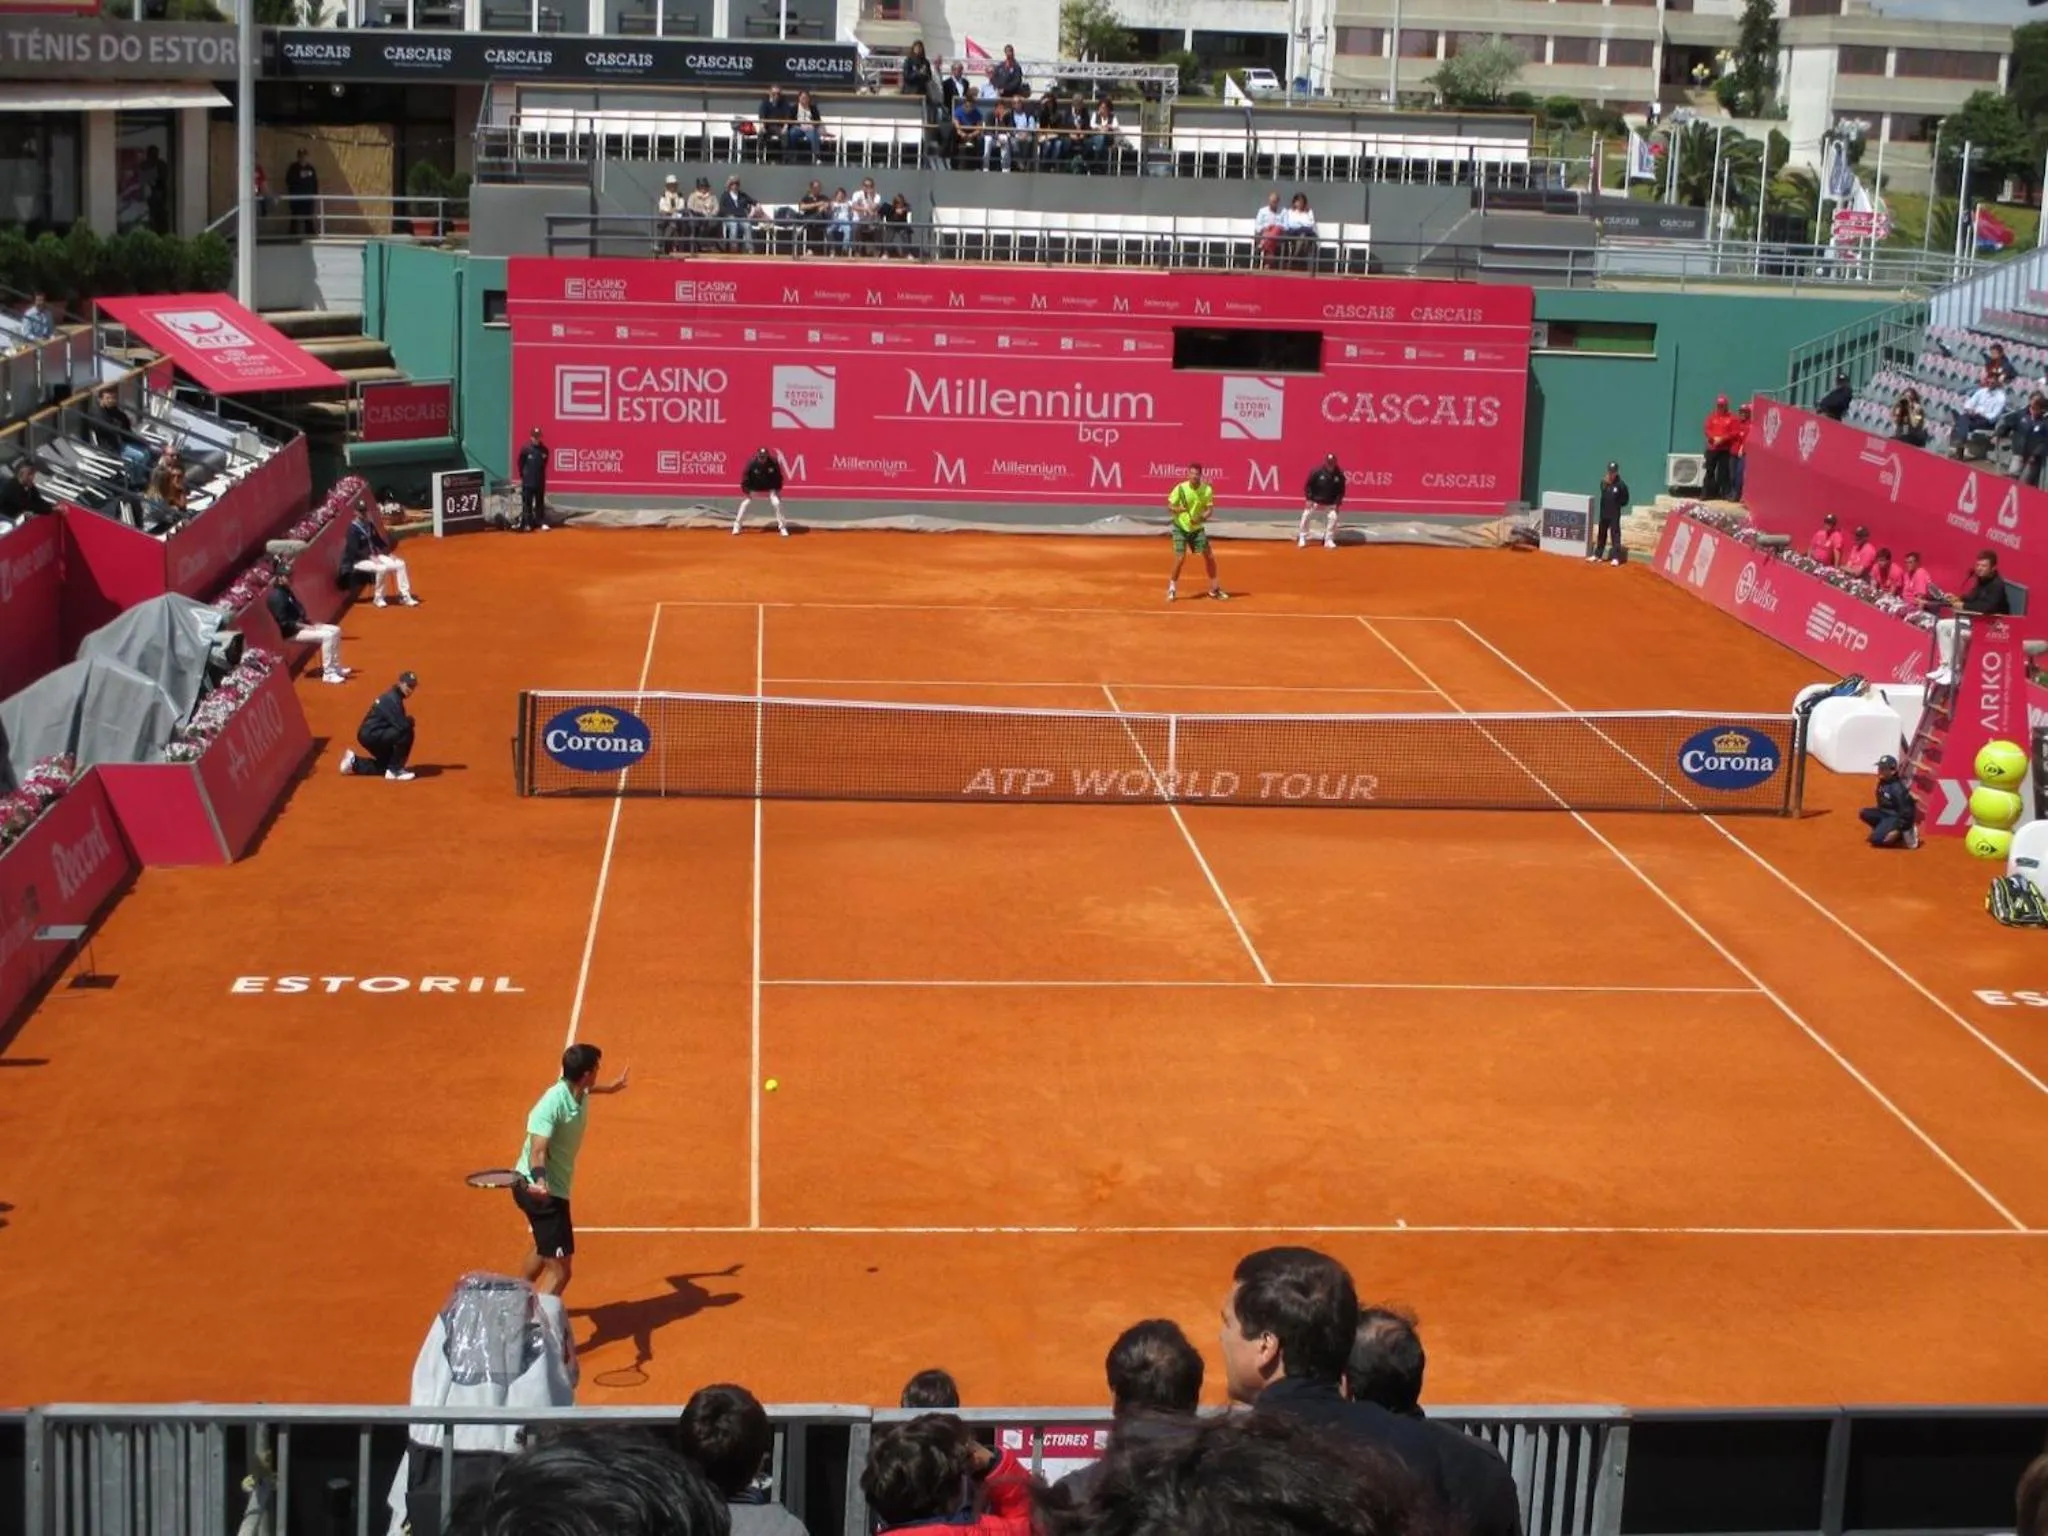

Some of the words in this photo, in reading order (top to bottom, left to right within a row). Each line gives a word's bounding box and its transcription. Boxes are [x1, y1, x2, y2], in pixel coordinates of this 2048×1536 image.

[8, 27, 91, 61] TÉNIS
[99, 35, 142, 62] DO
[150, 36, 260, 64] ESTOR
[284, 44, 351, 58] CASCAIS
[384, 46, 452, 61] CASCAIS
[484, 49, 552, 64] CASCAIS
[585, 52, 653, 66] CASCAIS
[686, 55, 753, 69] CASCAIS
[786, 57, 853, 72] CASCAIS
[587, 279, 627, 289] CASINO
[697, 281, 737, 291] CASINO
[587, 289, 626, 300] ESTORIL
[697, 291, 737, 303] ESTORIL
[1322, 304, 1395, 319] CASCAIS
[1410, 307, 1482, 322] CASCAIS
[195, 334, 239, 346] ATP
[617, 367, 728, 394] CASINO
[904, 367, 1154, 419] Millennium
[366, 402, 448, 424] CASCAIS
[617, 397, 727, 424] ESTORIL
[1320, 391, 1501, 427] CASCAIS
[1078, 421, 1119, 446] bcp
[578, 449, 624, 461] CASINO
[682, 451, 727, 463] CASINO
[832, 454, 908, 471] Millennium
[578, 461, 623, 473] ESTORIL
[682, 462, 726, 475] ESTORIL
[932, 450, 967, 485] M
[991, 458, 1067, 475] Millennium
[1089, 453, 1122, 488] M
[1150, 461, 1224, 478] Millenum
[1248, 458, 1280, 492] M
[1344, 470, 1393, 486] SCAIS
[1422, 472, 1497, 489] CASCAIS
[446, 494, 479, 513] 0:27
[1831, 622, 1868, 652] RTP
[1980, 652, 2002, 732] ARKO
[545, 729, 645, 753] Corona
[1682, 750, 1774, 773] Corona
[962, 767, 1055, 795] ATP
[1071, 768, 1240, 798] WORLD
[1256, 771, 1379, 800] TOUR
[229, 975, 526, 994] ESTORIL
[1971, 990, 2048, 1007] ES
[1028, 1433, 1089, 1447] SCTORES
